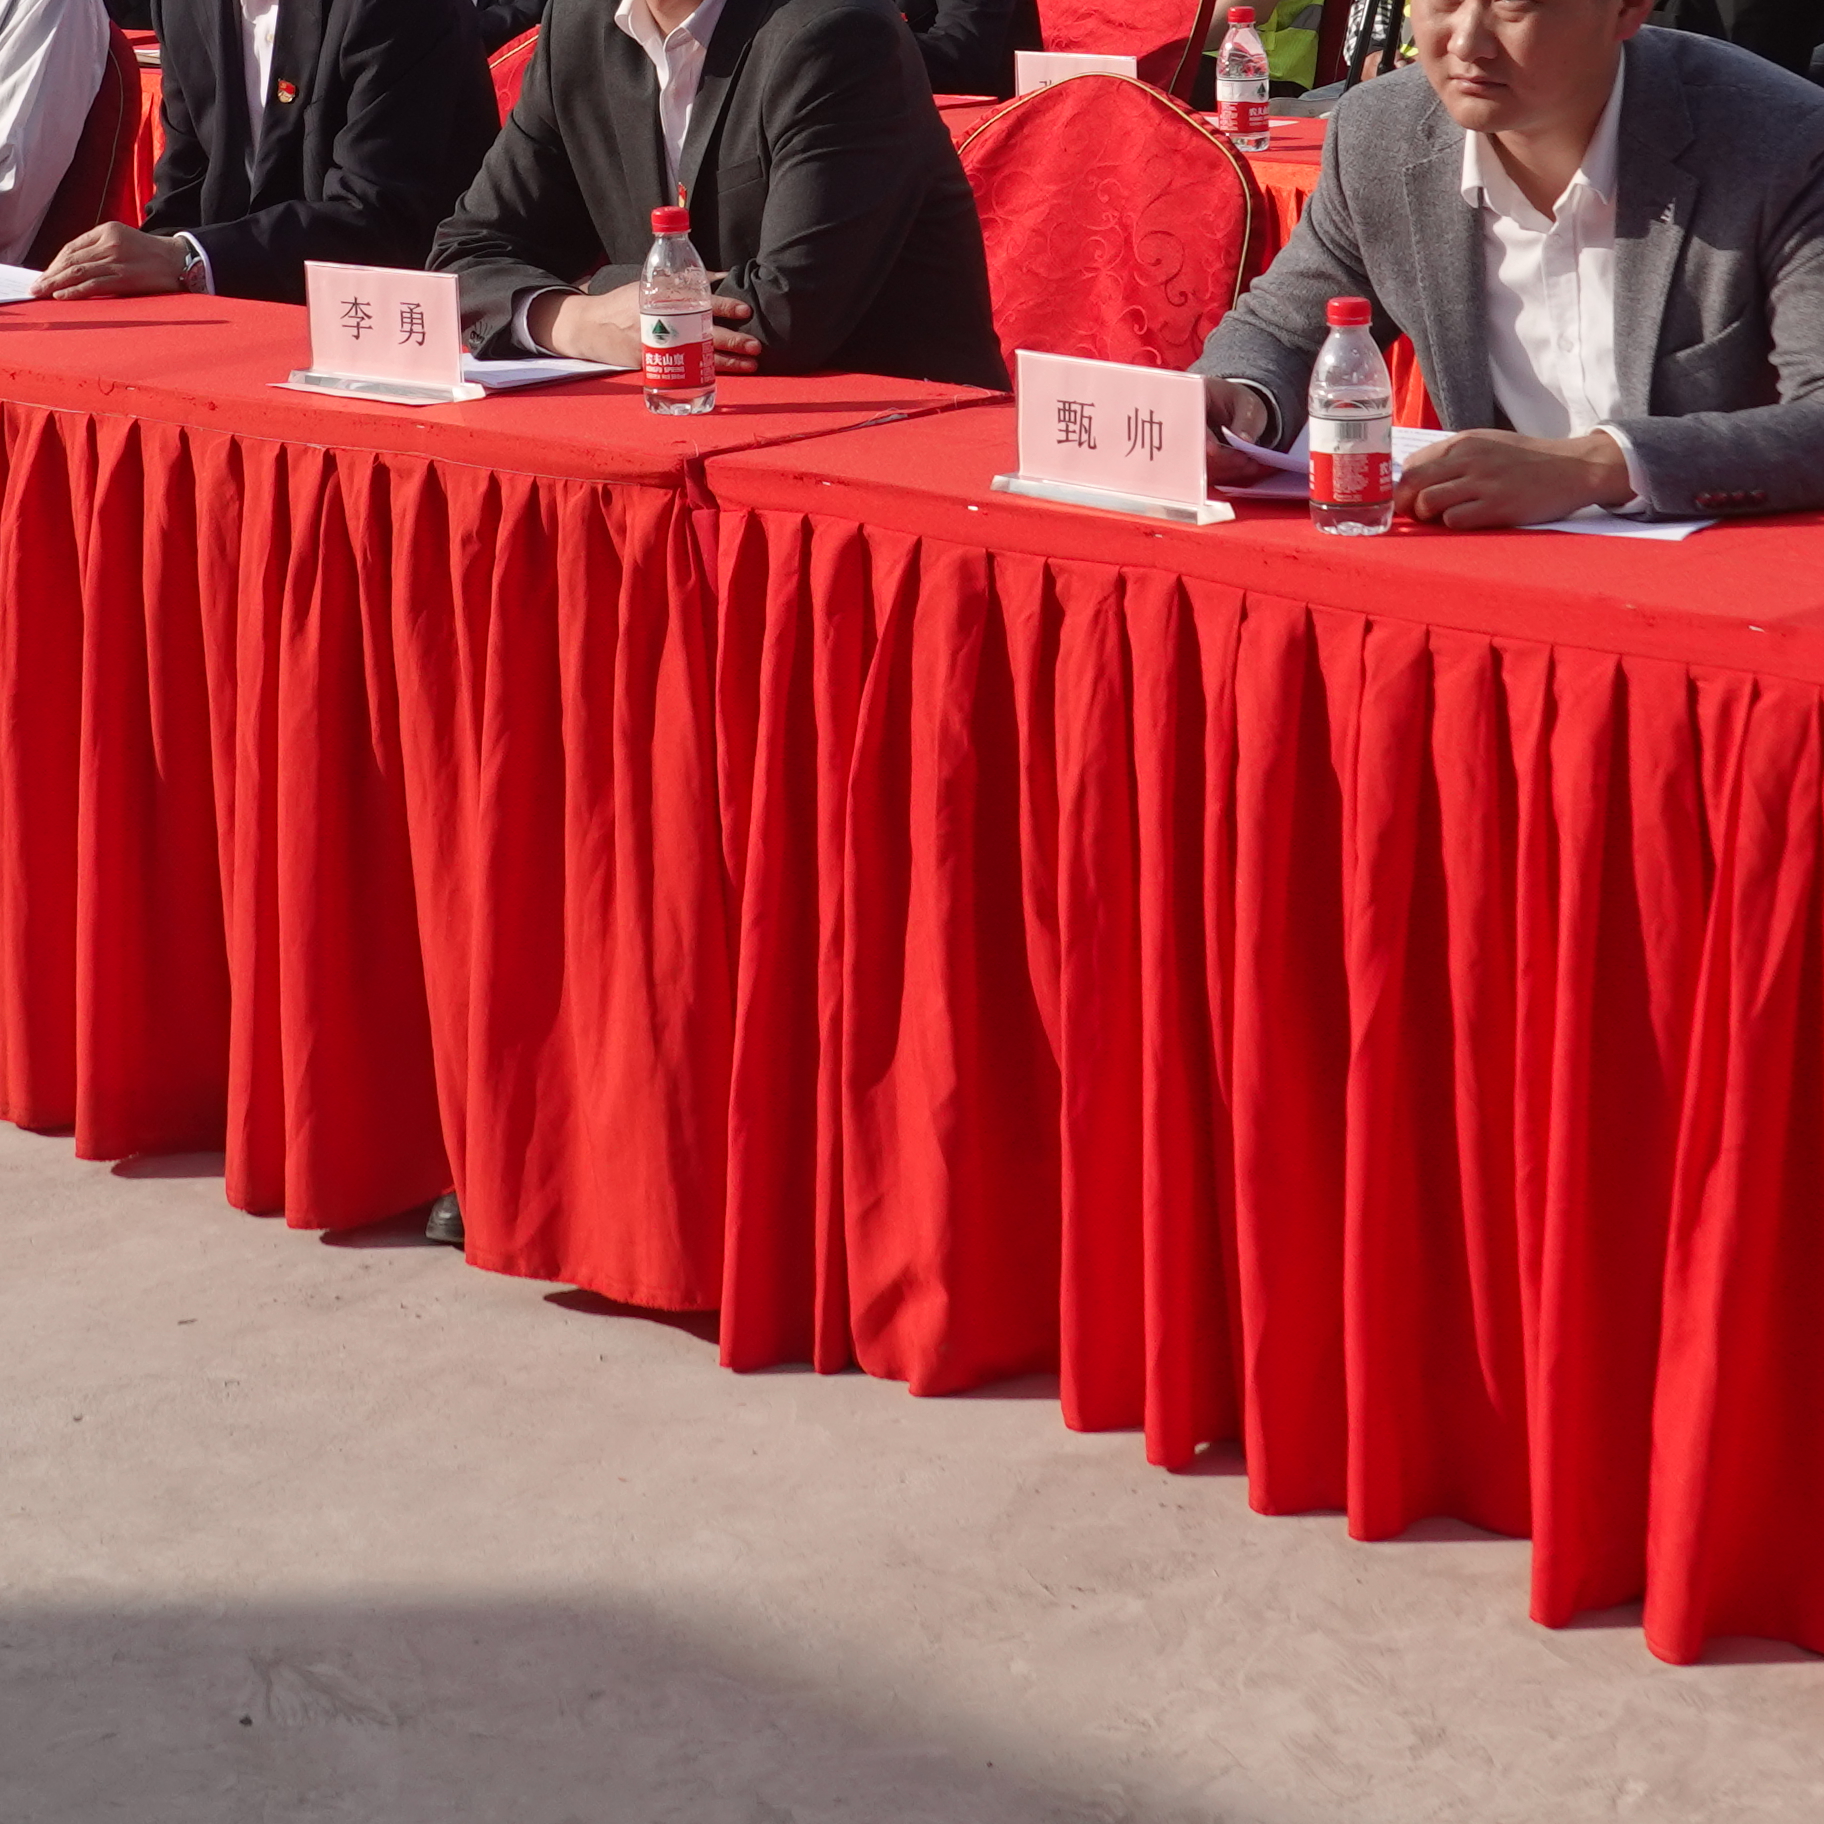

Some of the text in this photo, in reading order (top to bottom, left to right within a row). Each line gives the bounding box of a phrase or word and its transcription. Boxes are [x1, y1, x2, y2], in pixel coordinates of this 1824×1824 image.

[340, 295, 427, 346] 李勇
[646, 353, 685, 365] 农夫山泉
[1056, 399, 1164, 461] 甄帅
